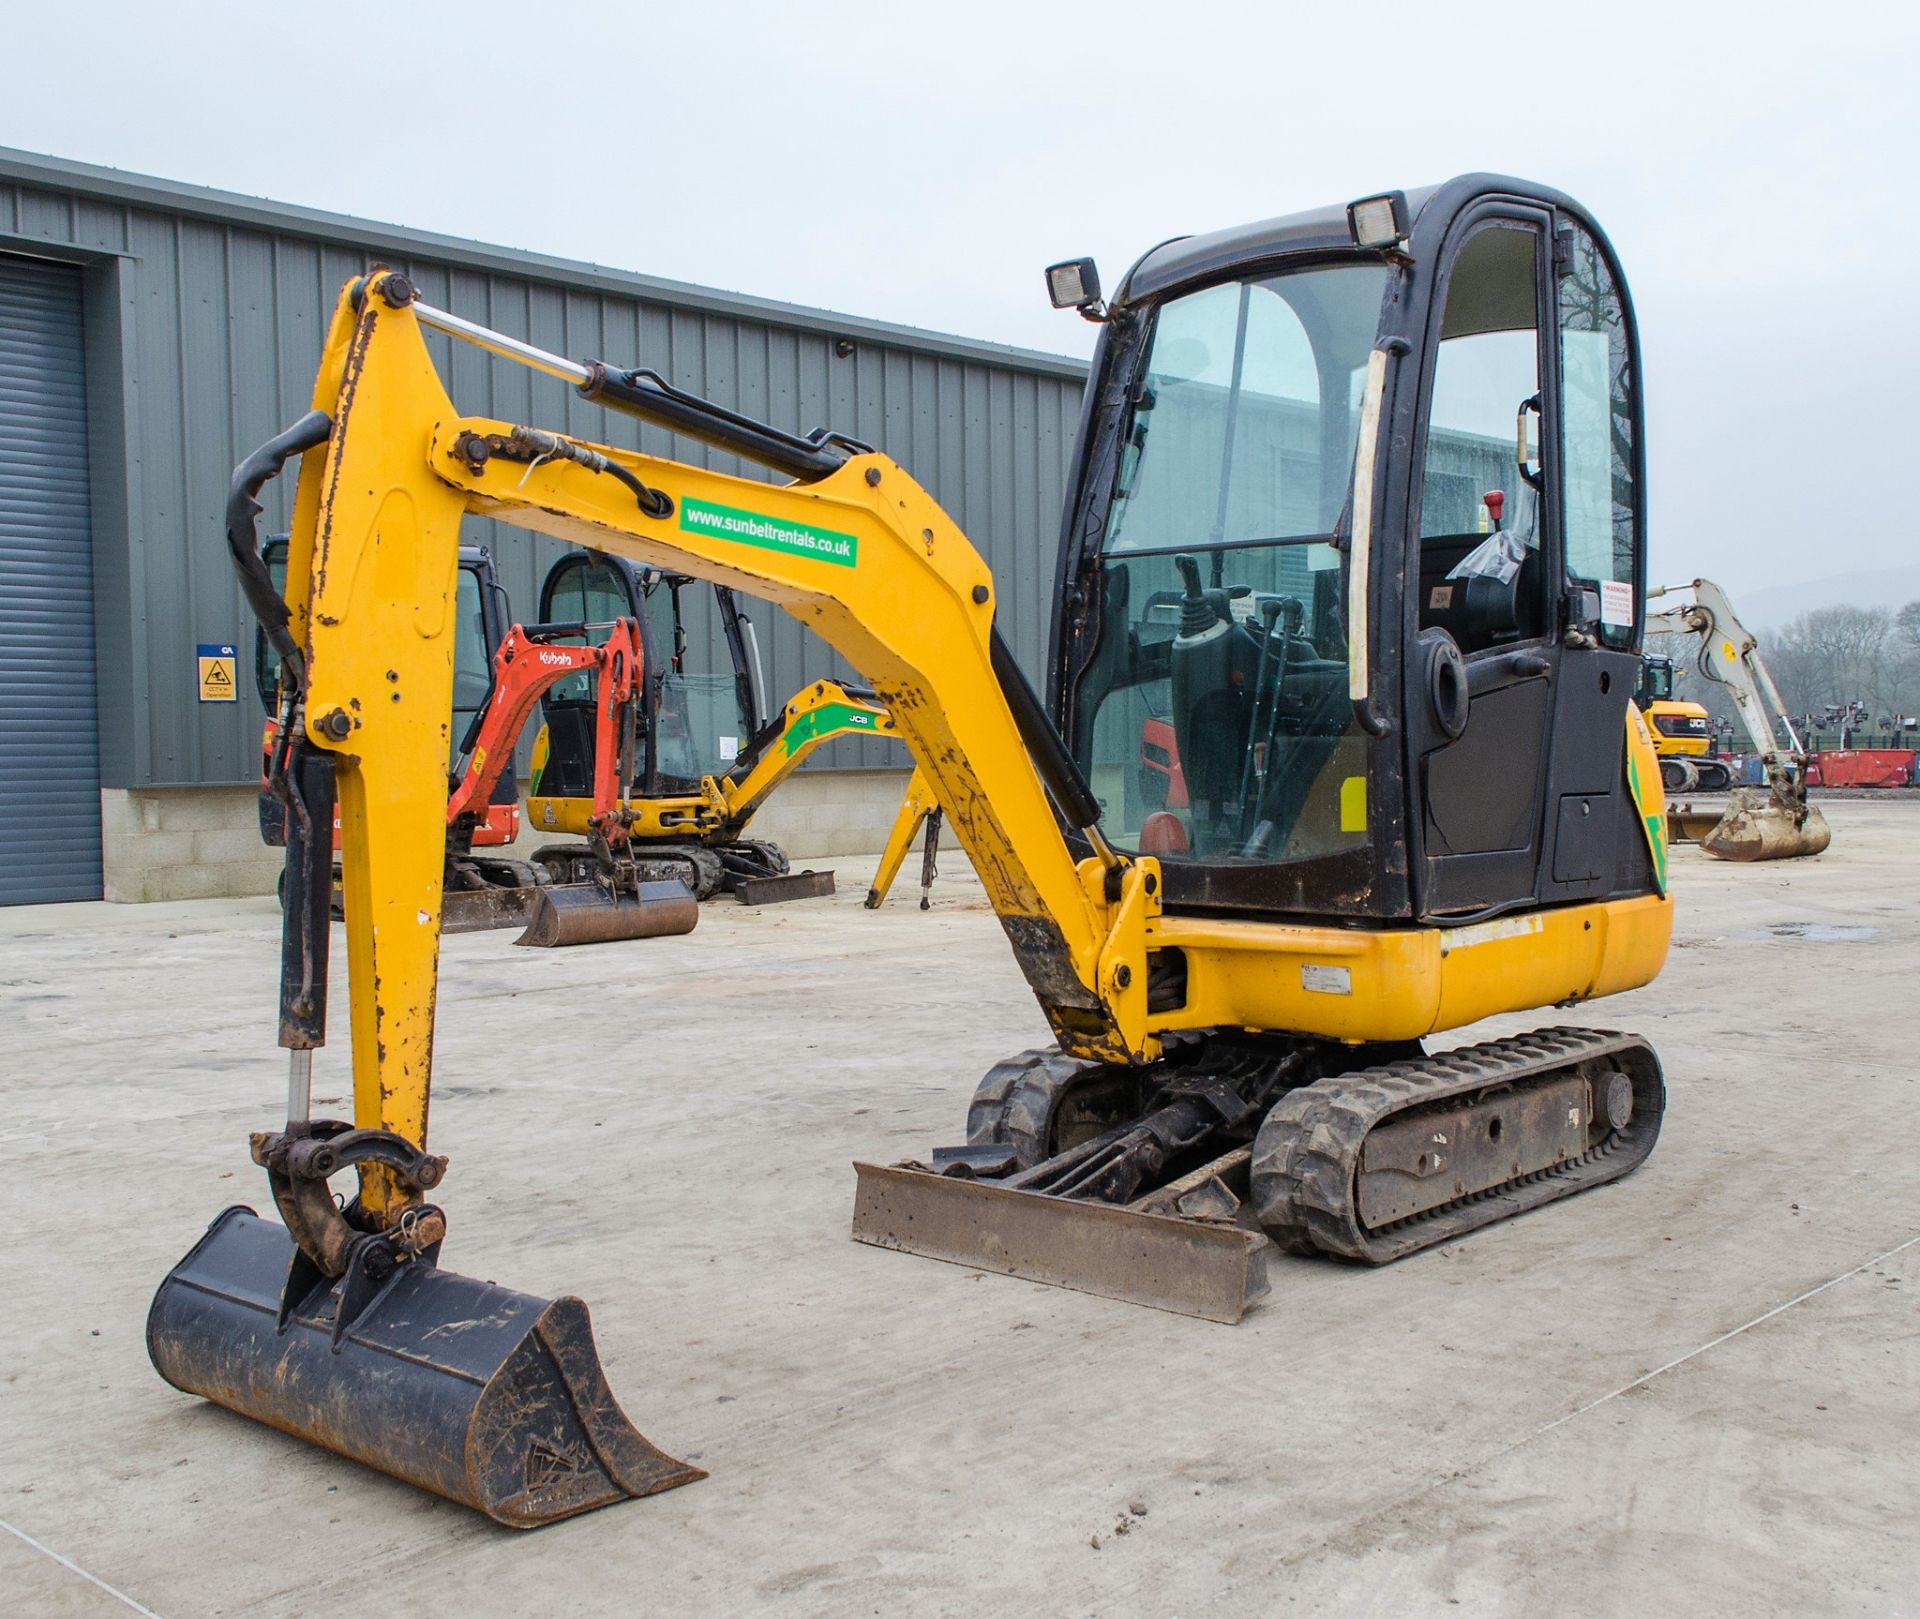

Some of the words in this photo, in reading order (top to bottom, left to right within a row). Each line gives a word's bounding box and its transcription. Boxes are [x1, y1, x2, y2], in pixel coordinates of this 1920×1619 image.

[687, 508, 850, 557] www.sunbeltrentals.co.uk
[539, 651, 572, 666] Kubota
[849, 714, 868, 724] JCB
